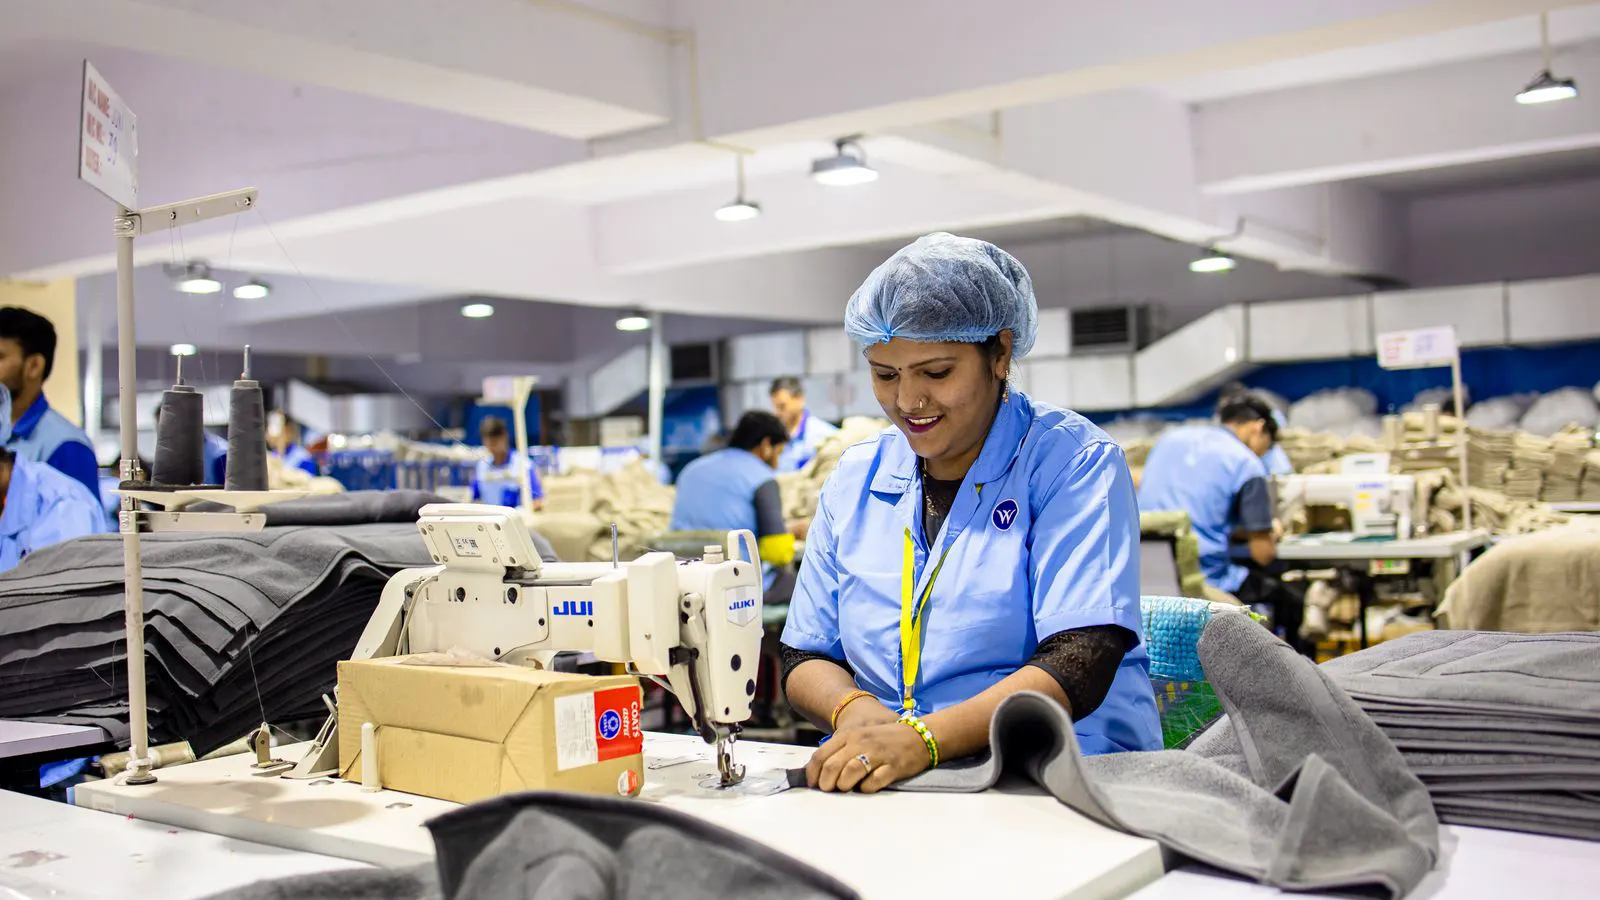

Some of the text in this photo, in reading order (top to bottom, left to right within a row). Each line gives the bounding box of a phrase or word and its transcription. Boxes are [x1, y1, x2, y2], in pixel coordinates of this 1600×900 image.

[996, 508, 1017, 525] W
[728, 599, 755, 611] JUKI
[622, 707, 630, 737] astra
[631, 701, 640, 738] COATS
